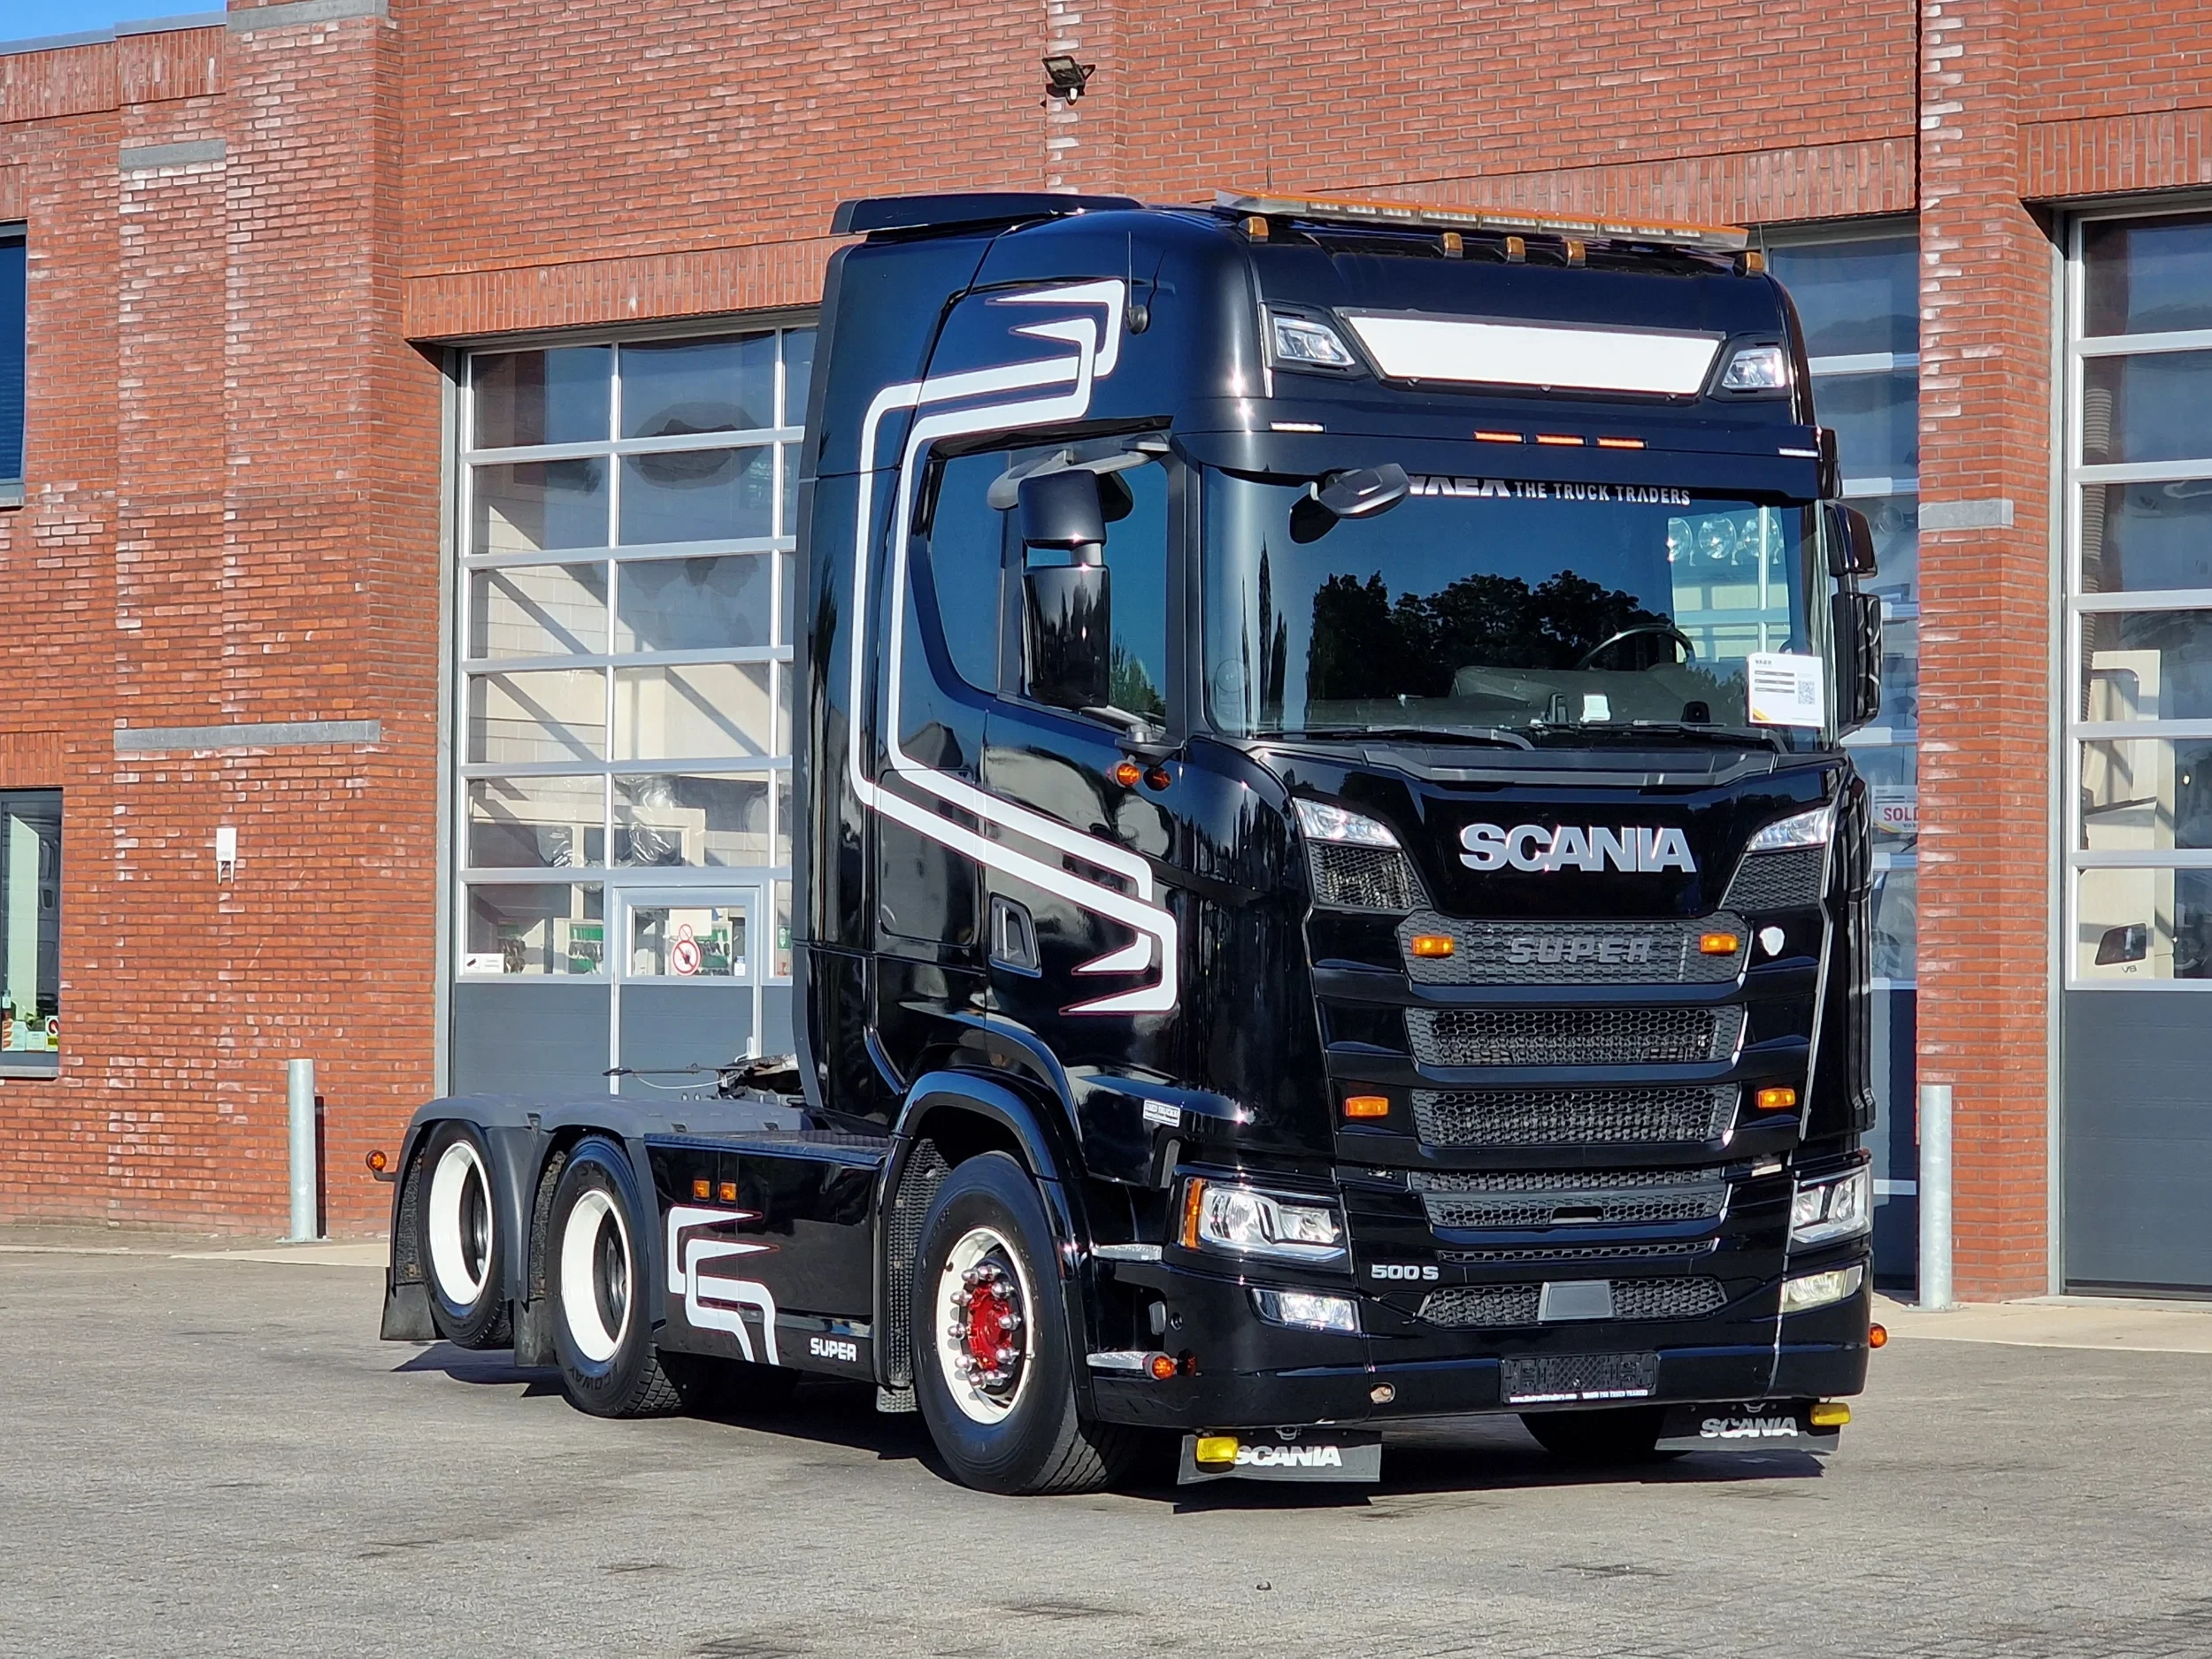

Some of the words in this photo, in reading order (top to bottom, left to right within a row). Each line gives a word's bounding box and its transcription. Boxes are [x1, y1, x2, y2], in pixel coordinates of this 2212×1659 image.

[1514, 481, 1548, 498] THE
[1553, 483, 1610, 502] TRUCK
[1615, 486, 1690, 505] TRADERS
[1460, 823, 1696, 872] SCANIA
[1508, 938, 1652, 964] SUPER
[1371, 1263, 1420, 1280] 500
[1422, 1266, 1439, 1280] S
[810, 1337, 856, 1363] SUPER
[1701, 1417, 1799, 1438] SCANIA
[1230, 1445, 1342, 1467] SCANIA
